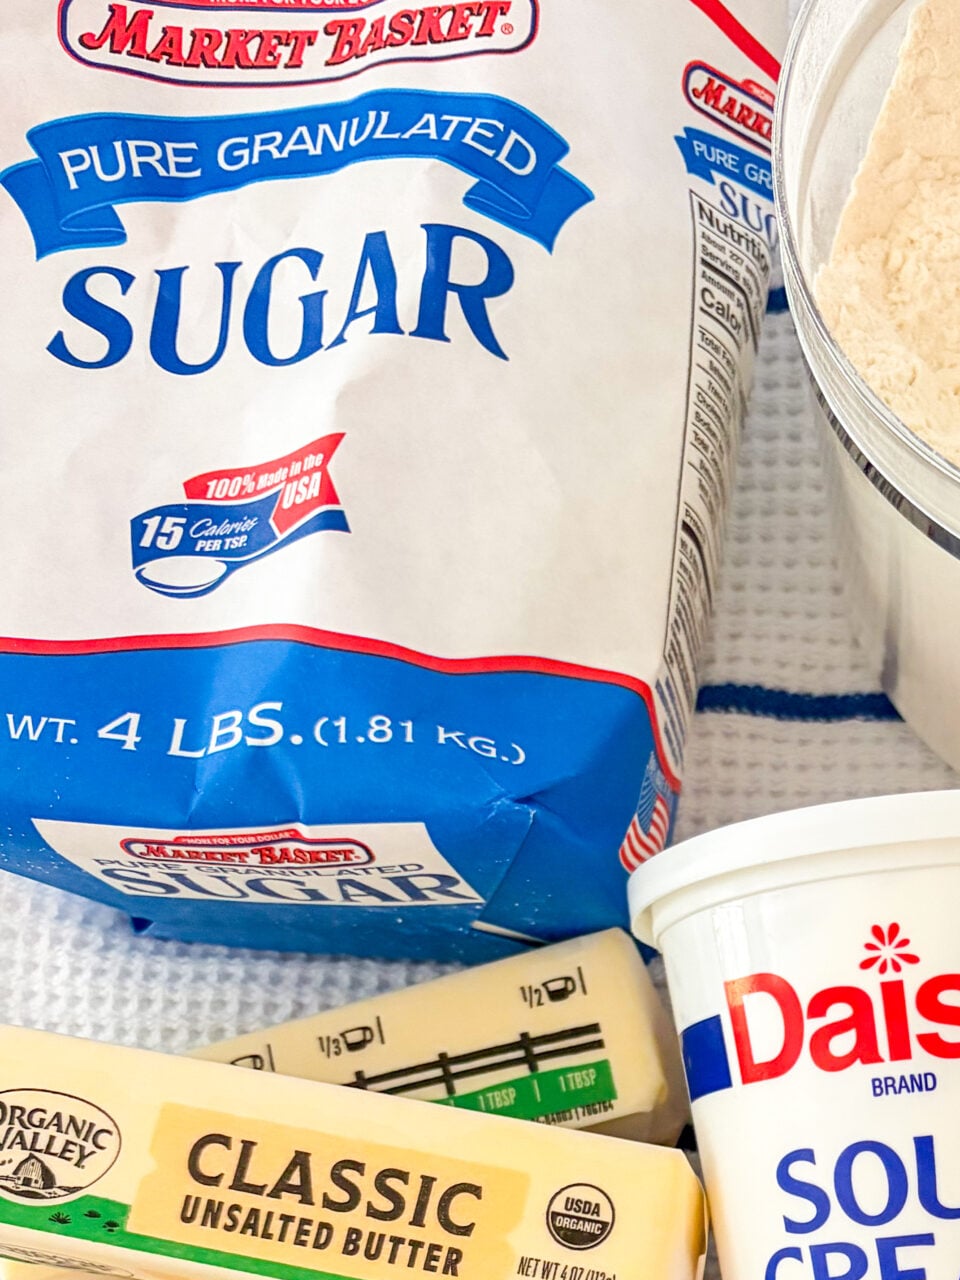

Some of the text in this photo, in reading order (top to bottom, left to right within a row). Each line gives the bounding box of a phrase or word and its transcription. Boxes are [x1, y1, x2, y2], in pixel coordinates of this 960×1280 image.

[79, 4, 510, 70] MARKET BASKET
[58, 110, 537, 190] PURE GRANULATED
[46, 224, 514, 376] SUGAR
[206, 453, 324, 499] 100% Made in the
[282, 471, 322, 510] USA
[139, 515, 259, 550] 15 Calories
[195, 536, 248, 551] PER TSP.
[6, 701, 527, 766] WT. 4 LBS. (1.81 KG.)
[93, 858, 424, 877] PURE GRANULATED
[144, 844, 360, 865] MARKET BASKET
[100, 868, 478, 903] SUGAR
[520, 984, 545, 1008] 1/2
[318, 1036, 342, 1059] 1/3
[872, 1072, 937, 1097] BRAND
[187, 1133, 483, 1238] CLASSIC
[564, 1197, 601, 1217] USDA
[180, 1194, 463, 1278] UNSALTED BUTTER
[555, 1216, 603, 1235] ORGANIC
[517, 1256, 541, 1278] NET
